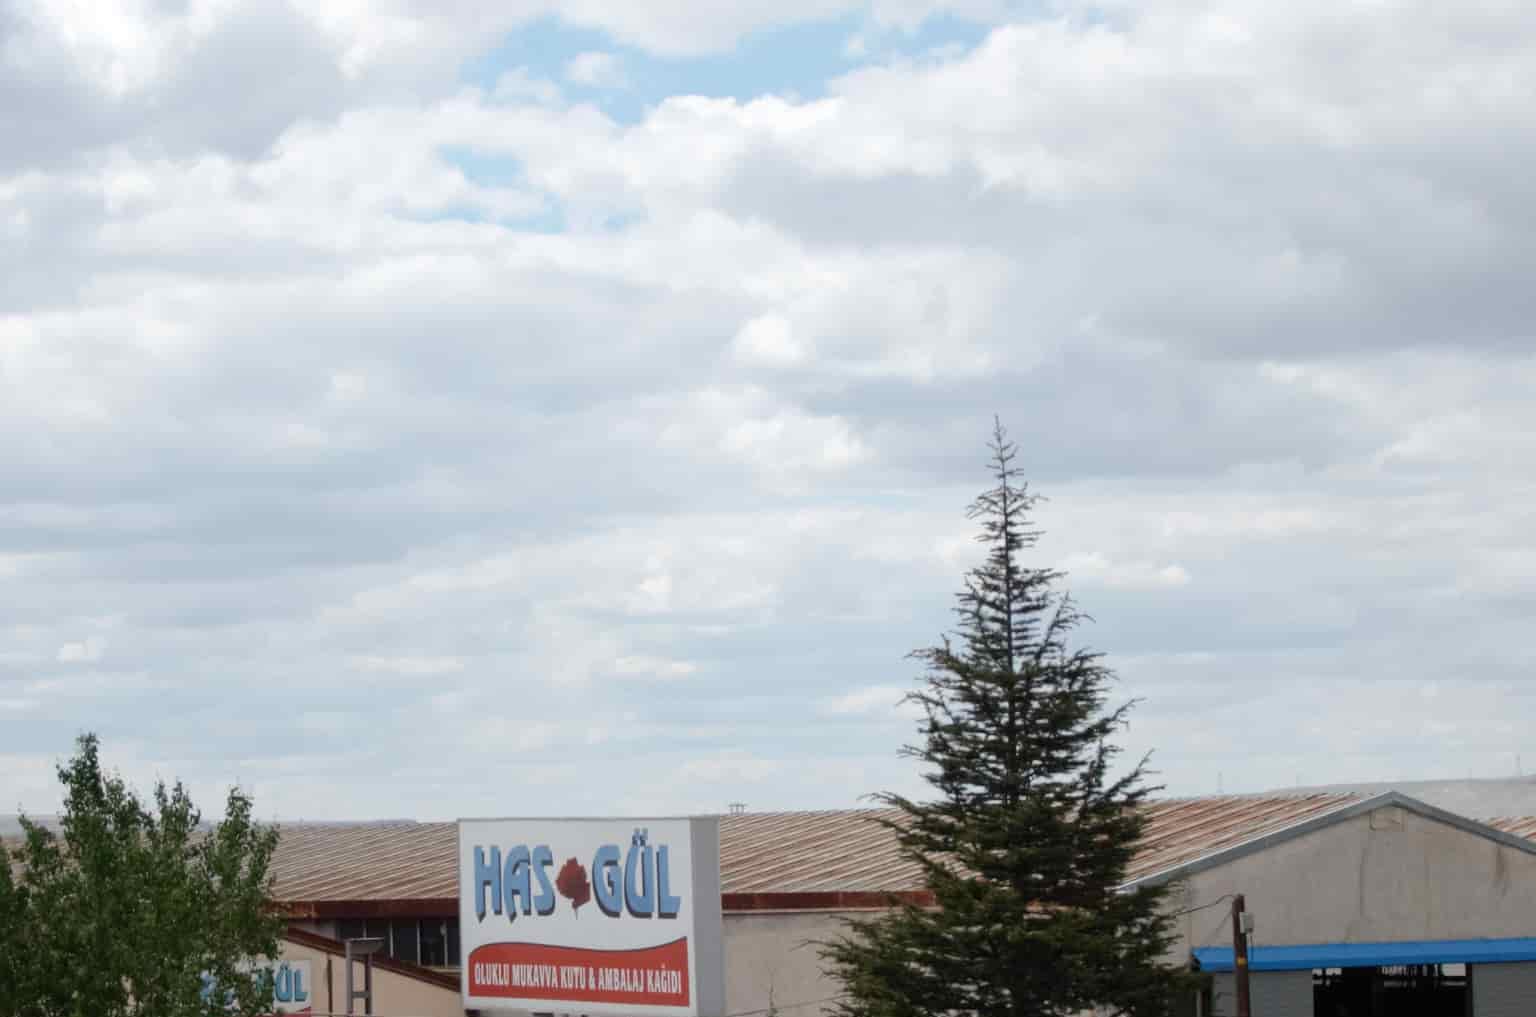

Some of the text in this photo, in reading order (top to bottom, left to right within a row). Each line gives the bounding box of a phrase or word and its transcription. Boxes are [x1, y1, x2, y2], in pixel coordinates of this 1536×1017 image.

[473, 828, 681, 923] HAS GÜL
[474, 963, 509, 986] OLUKLU
[512, 965, 558, 989] MUKAVVA
[560, 967, 586, 990] KUTU
[589, 968, 595, 990] &
[598, 969, 644, 993] AMBALAJ
